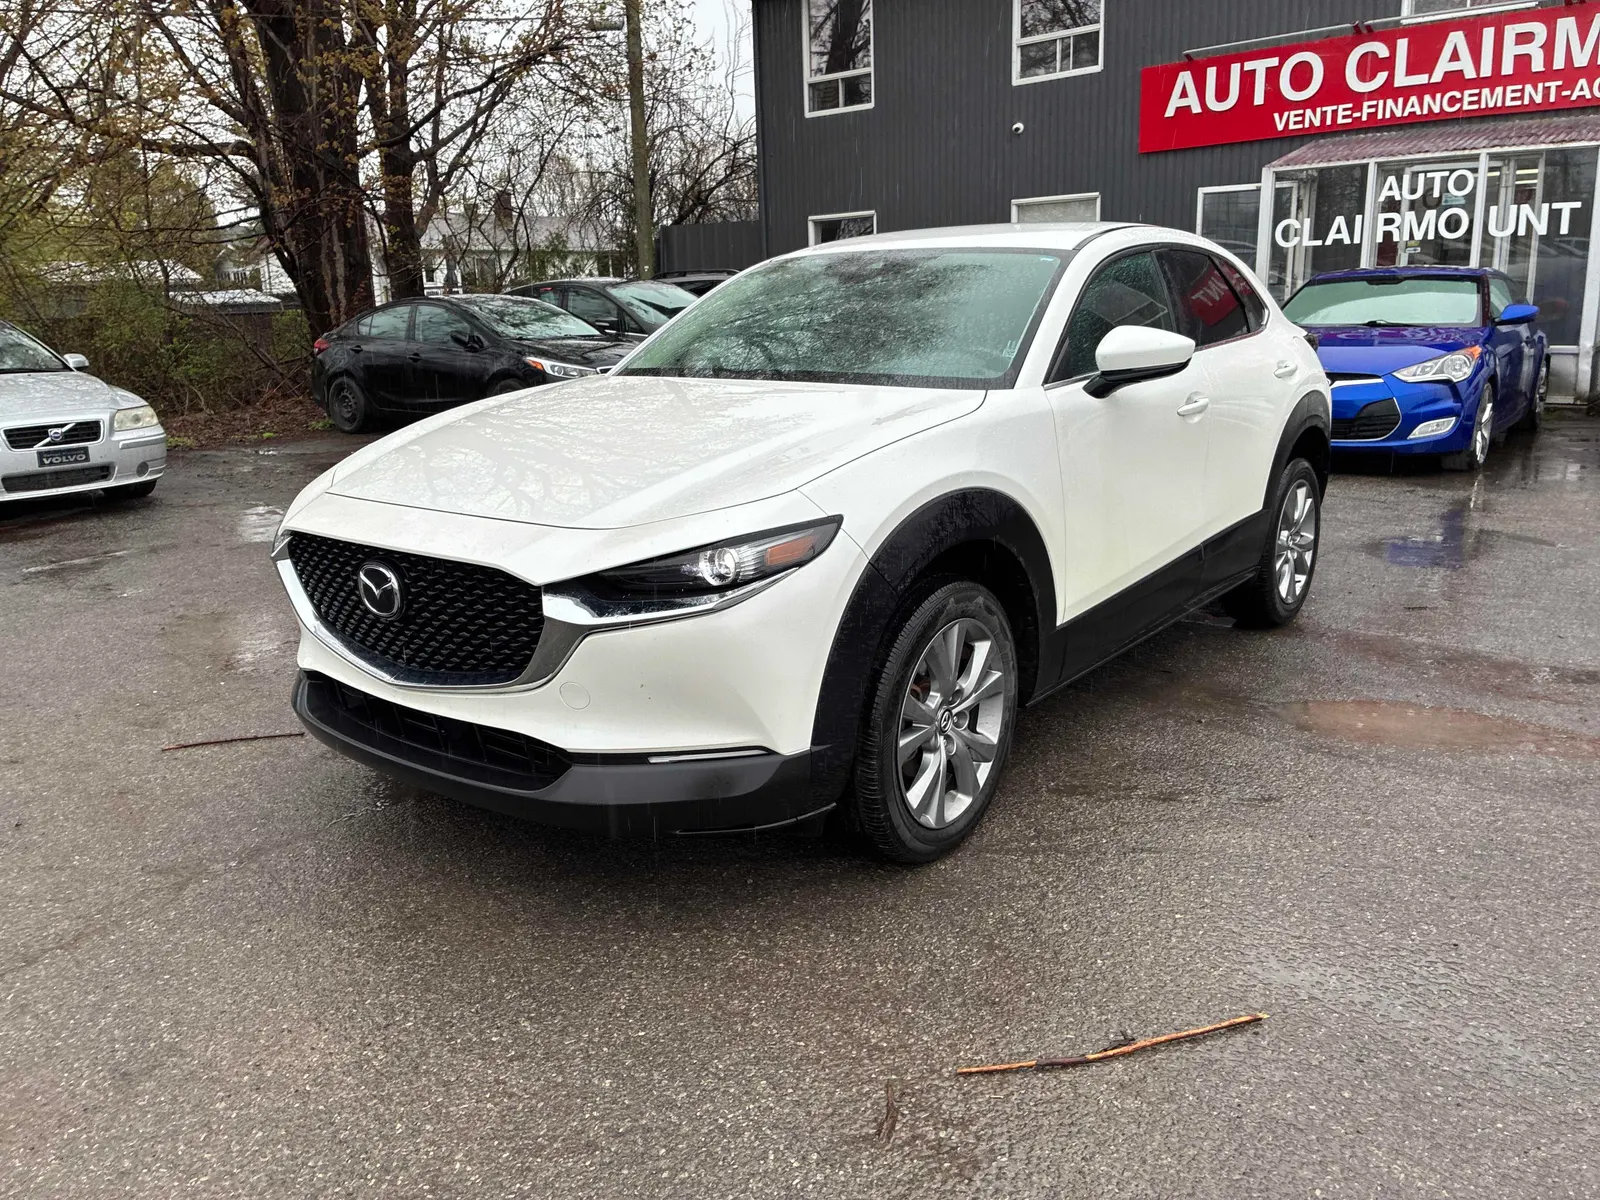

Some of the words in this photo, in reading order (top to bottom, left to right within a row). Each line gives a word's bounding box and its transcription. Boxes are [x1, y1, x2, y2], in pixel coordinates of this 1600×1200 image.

[1164, 51, 1324, 117] AUTO
[1378, 169, 1475, 202] AUTO
[43, 454, 86, 464] VOLVO
